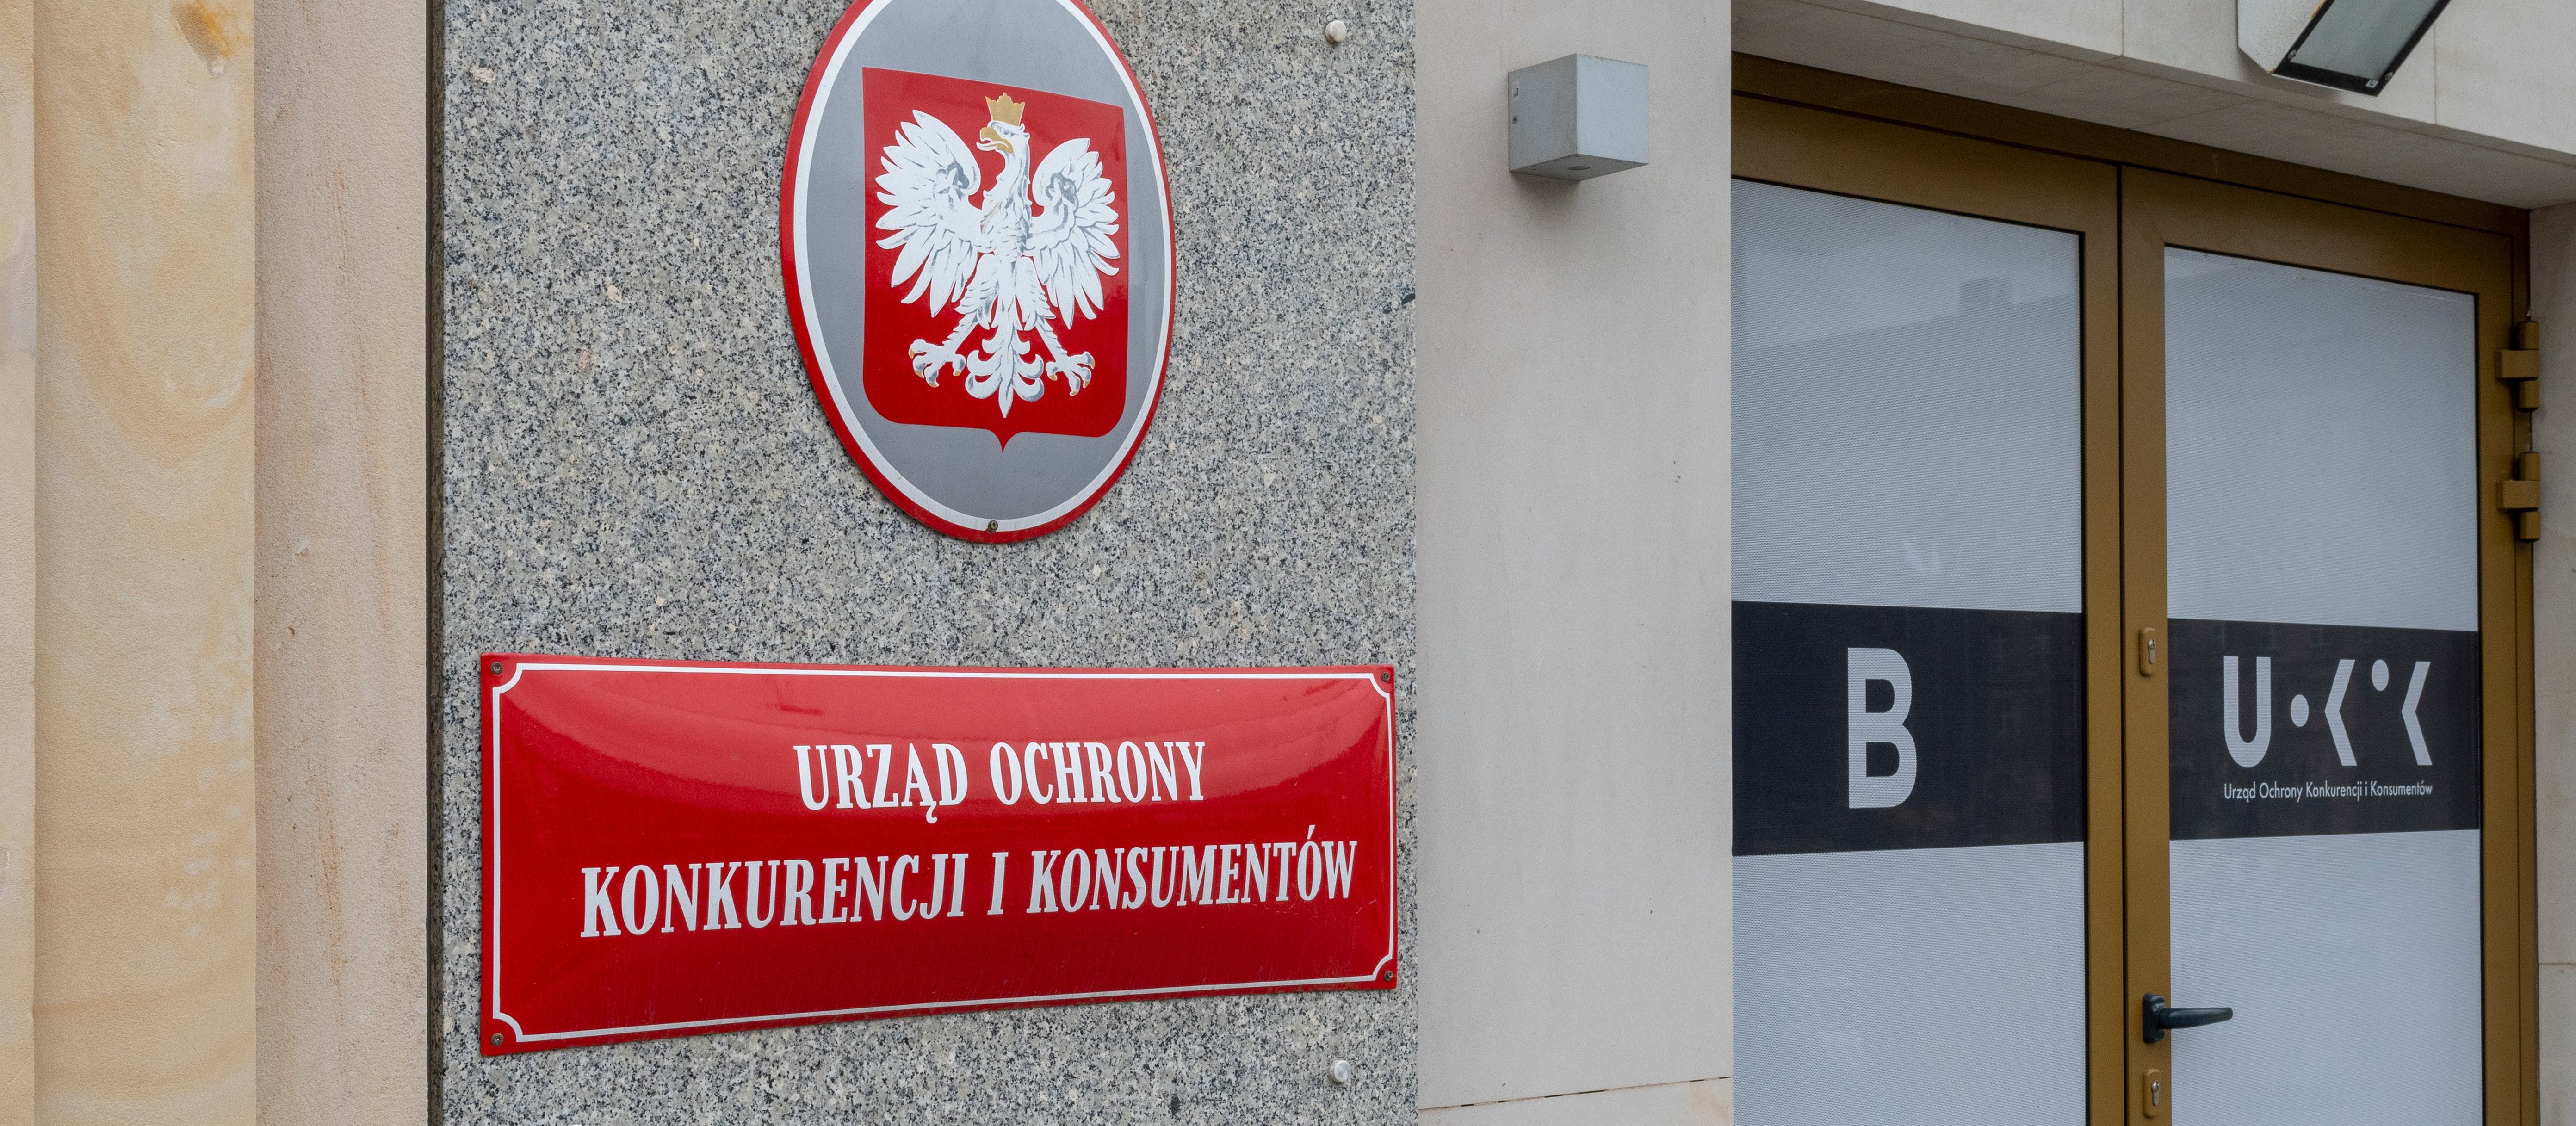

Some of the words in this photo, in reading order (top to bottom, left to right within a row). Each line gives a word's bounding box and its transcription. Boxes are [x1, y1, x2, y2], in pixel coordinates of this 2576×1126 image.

[1847, 647, 1917, 809] B
[793, 742, 968, 824] URZĄD
[990, 741, 1205, 805] OCHRONY
[2224, 781, 2256, 803] Urząd
[2259, 781, 2303, 803] Ochrony
[2306, 780, 2362, 801] Konkurencji
[2365, 781, 2368, 796] i
[2371, 780, 2433, 796] Konsumentów
[580, 853, 969, 938] KONKURENCJI
[987, 852, 1009, 915] I
[1026, 824, 1357, 913] KONSUMENTÓW
